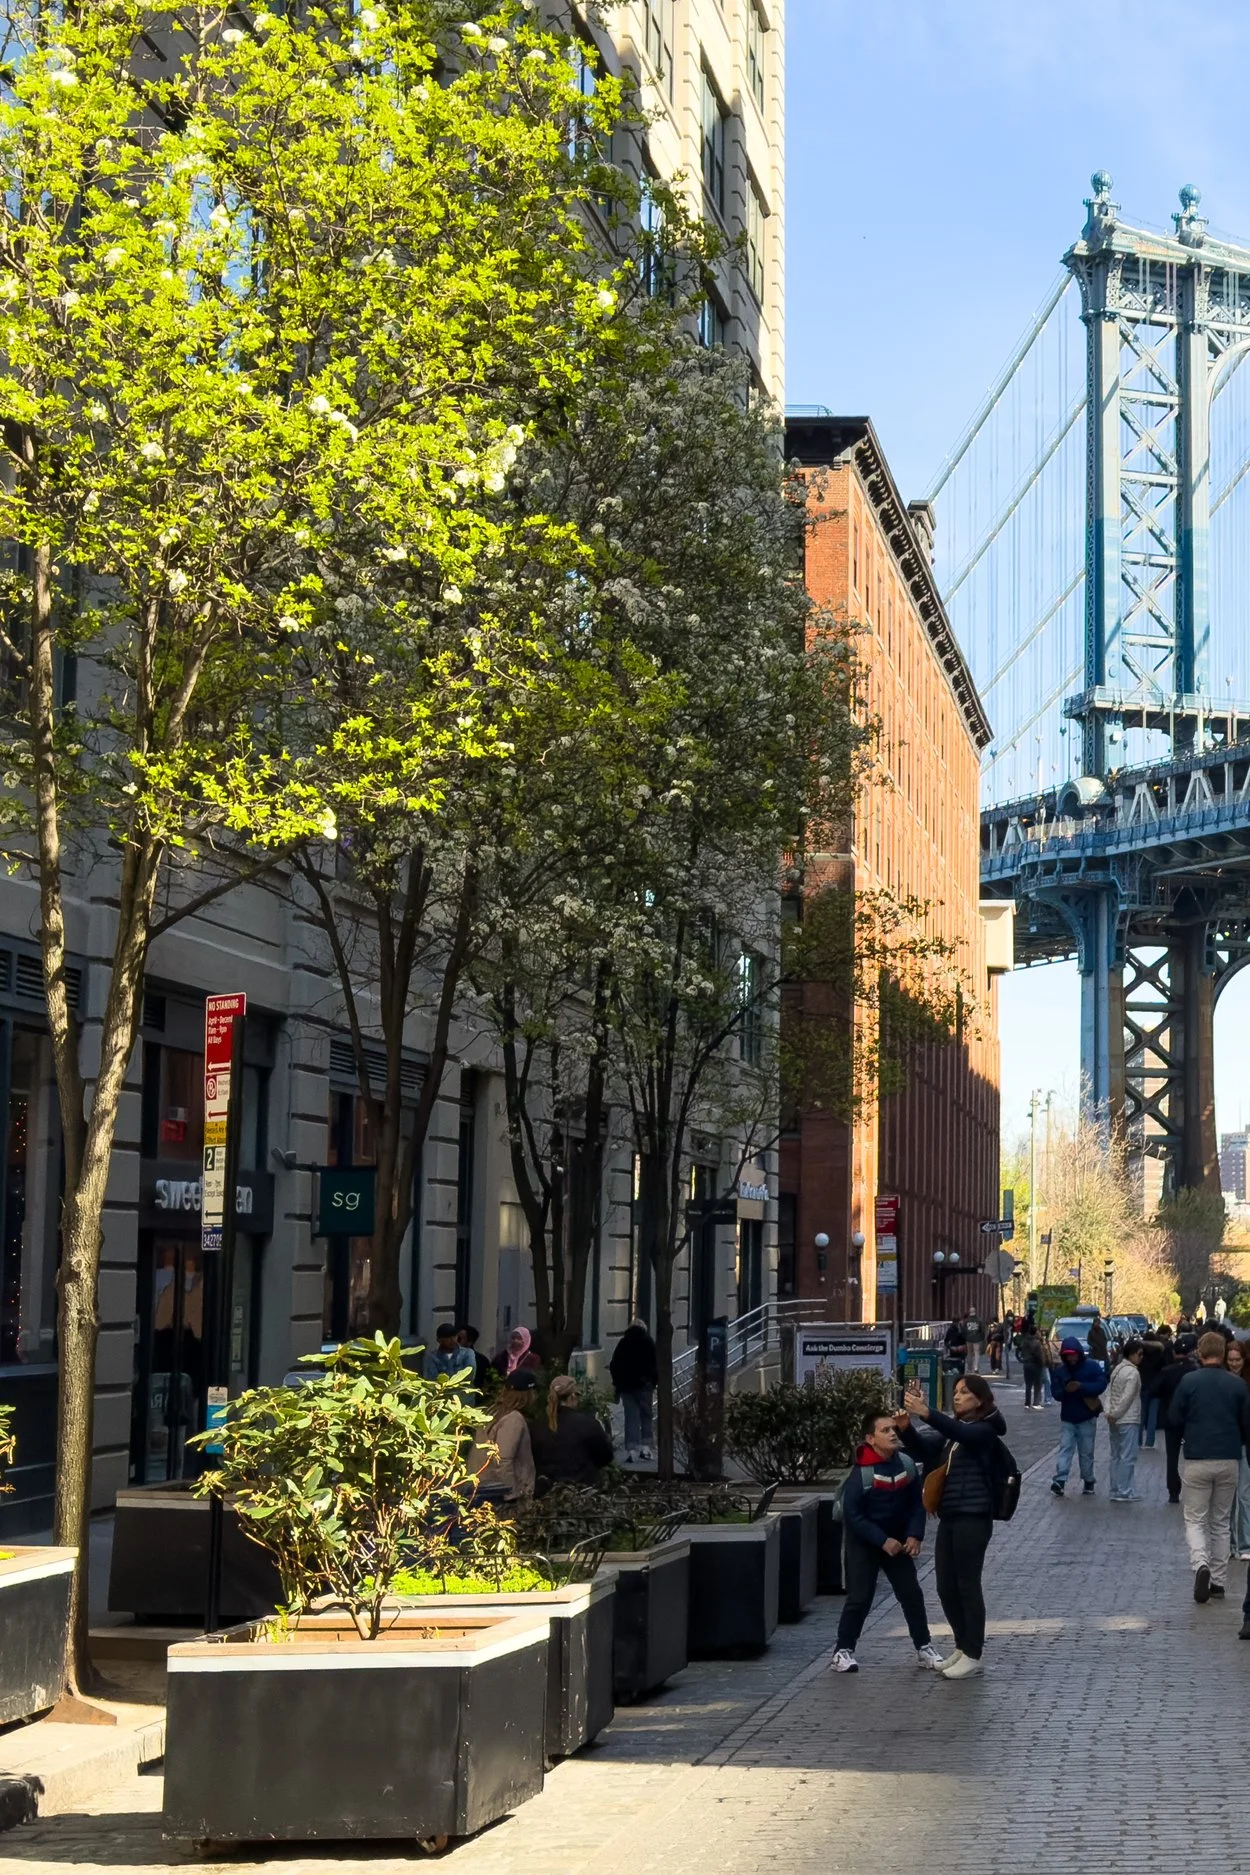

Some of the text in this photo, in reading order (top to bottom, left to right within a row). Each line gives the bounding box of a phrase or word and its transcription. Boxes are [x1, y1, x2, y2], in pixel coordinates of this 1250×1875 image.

[208, 998, 239, 1011] NO STANDING
[206, 1148, 213, 1170] 2
[331, 1191, 361, 1211] sg
[805, 1343, 884, 1353] Ask the Dumbo Concierge
